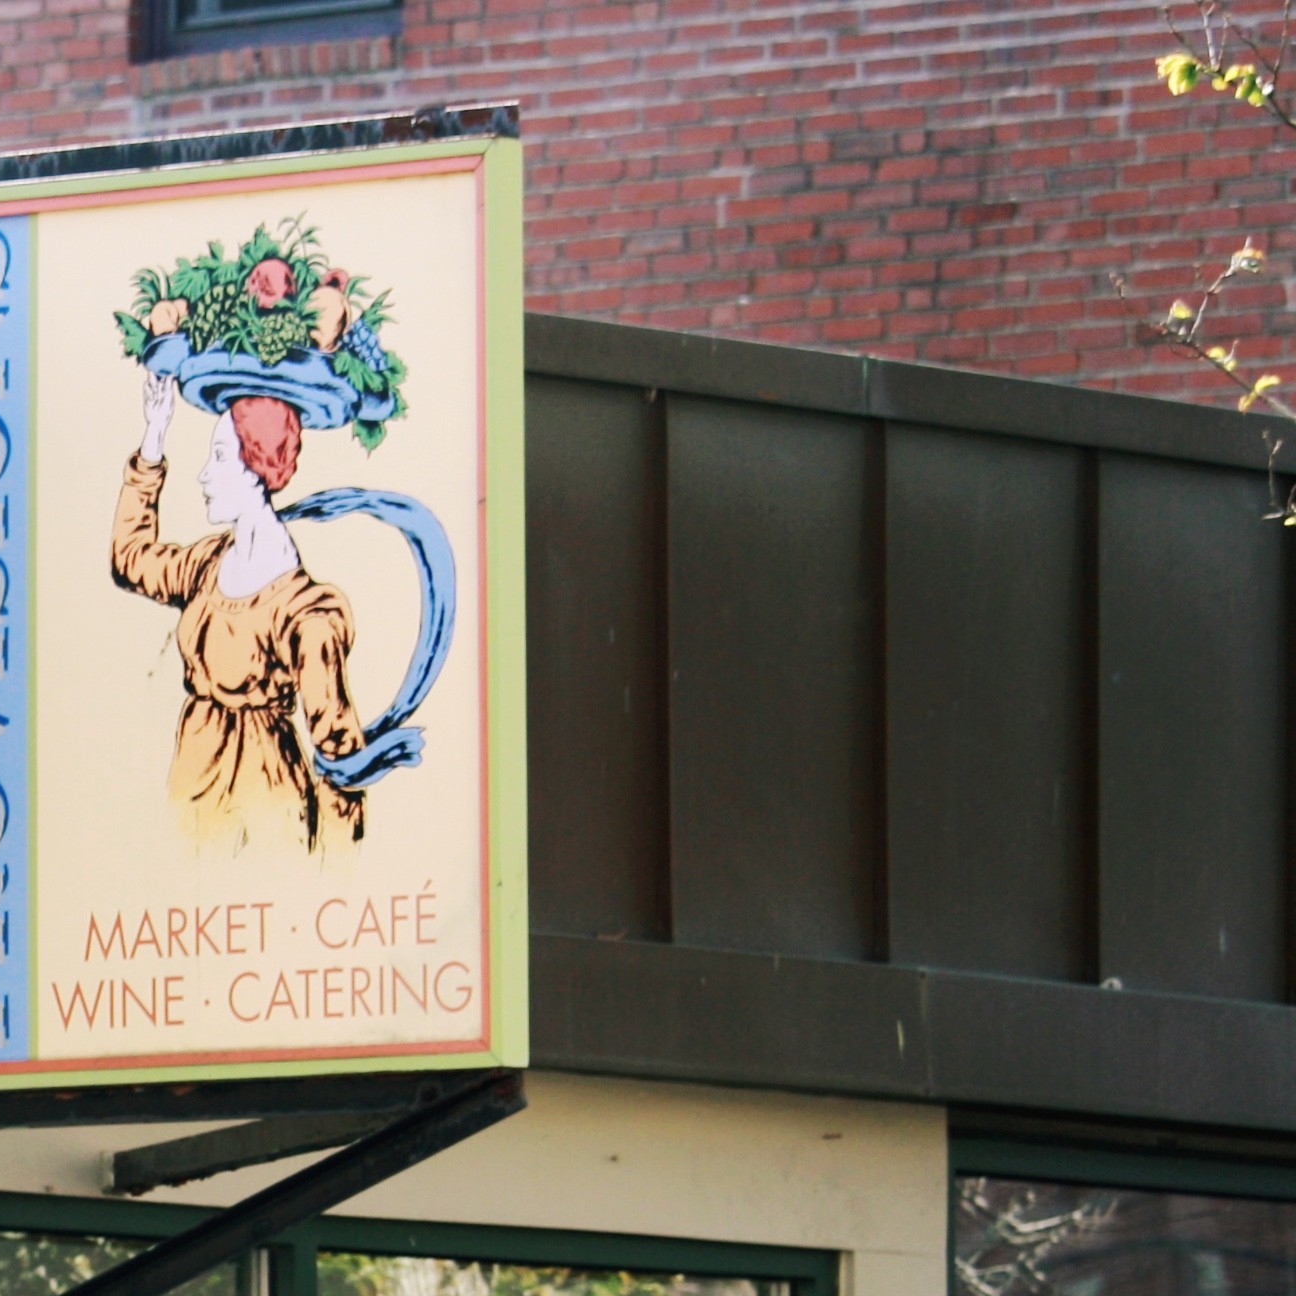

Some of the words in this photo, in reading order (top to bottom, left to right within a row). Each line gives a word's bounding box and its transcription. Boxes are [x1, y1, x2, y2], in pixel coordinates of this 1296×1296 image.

[84, 902, 273, 964] MARKET
[314, 879, 440, 948] CAFÉ
[51, 975, 186, 1032] WINE
[227, 960, 474, 1026] CATERING
